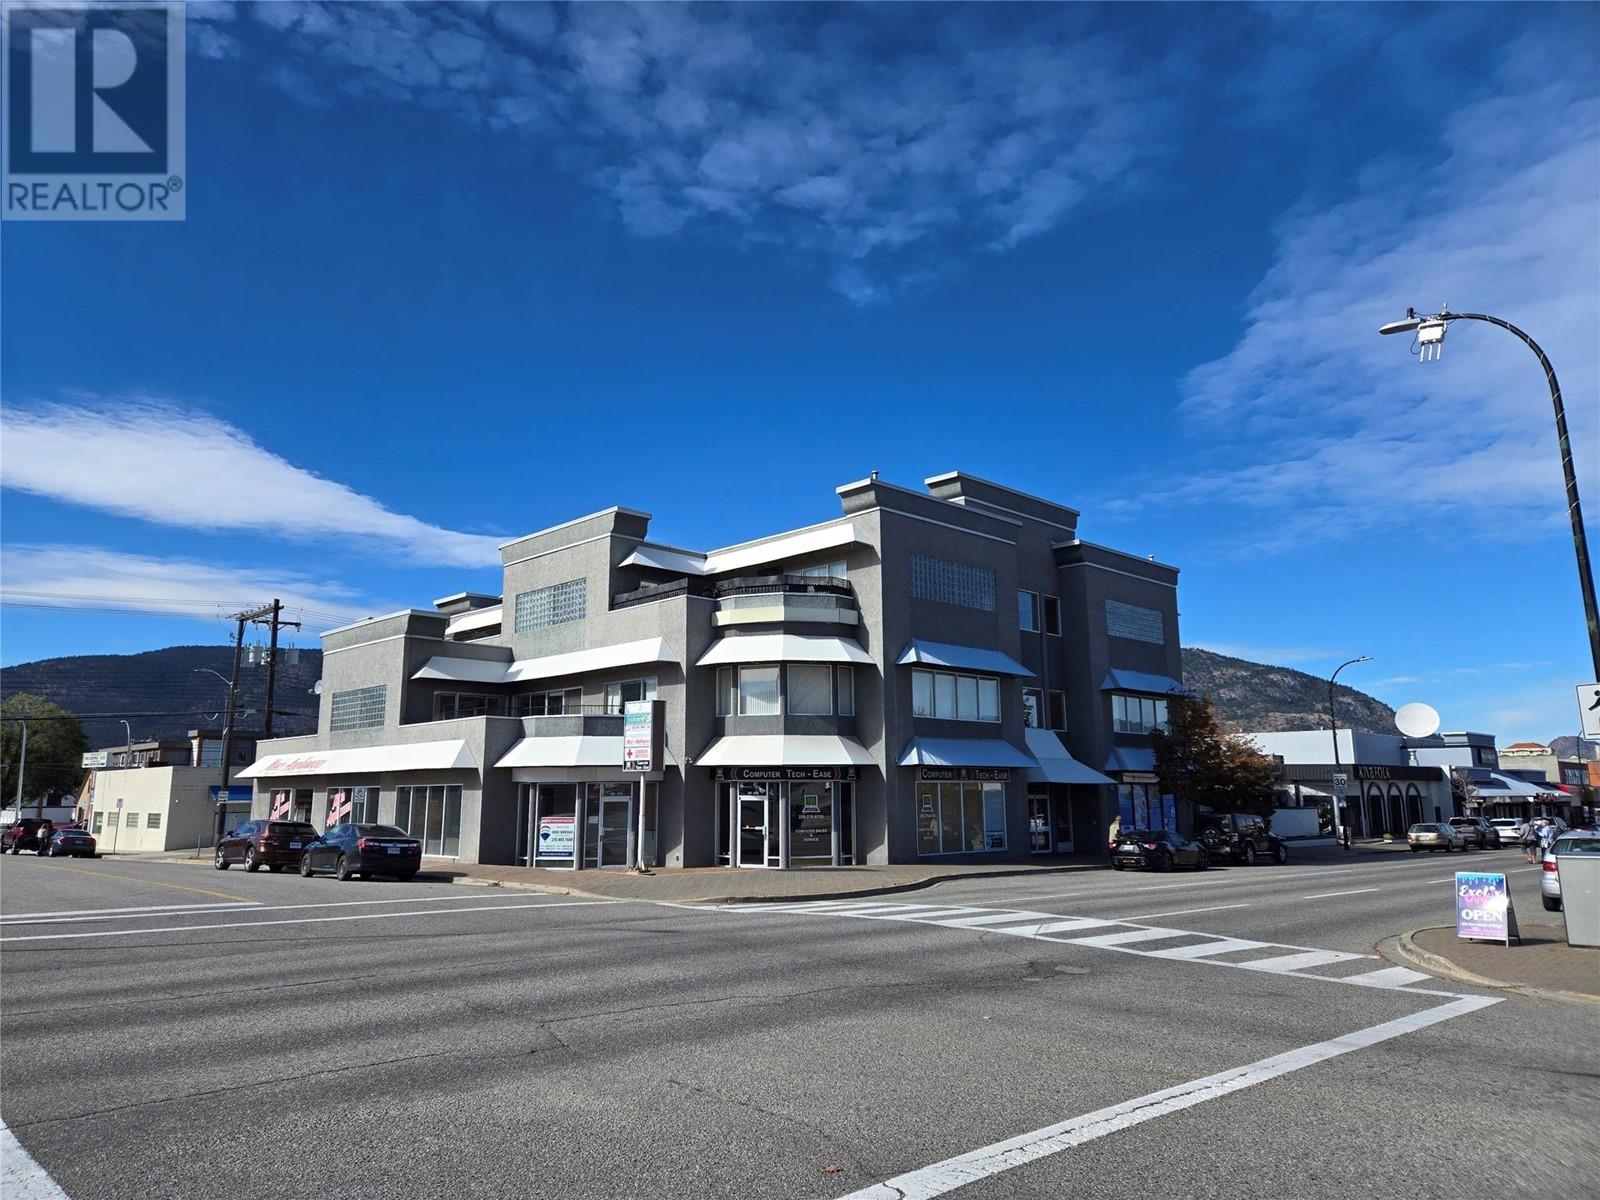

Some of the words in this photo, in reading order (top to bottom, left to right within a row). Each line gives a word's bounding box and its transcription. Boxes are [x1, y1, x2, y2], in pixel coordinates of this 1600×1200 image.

[743, 769, 780, 778] COMPUTER
[786, 768, 806, 778] TECH
[813, 769, 832, 778] EASE
[922, 768, 953, 779] COMPUTER
[1334, 778, 1346, 786] 30
[1461, 909, 1503, 922] OPEN
